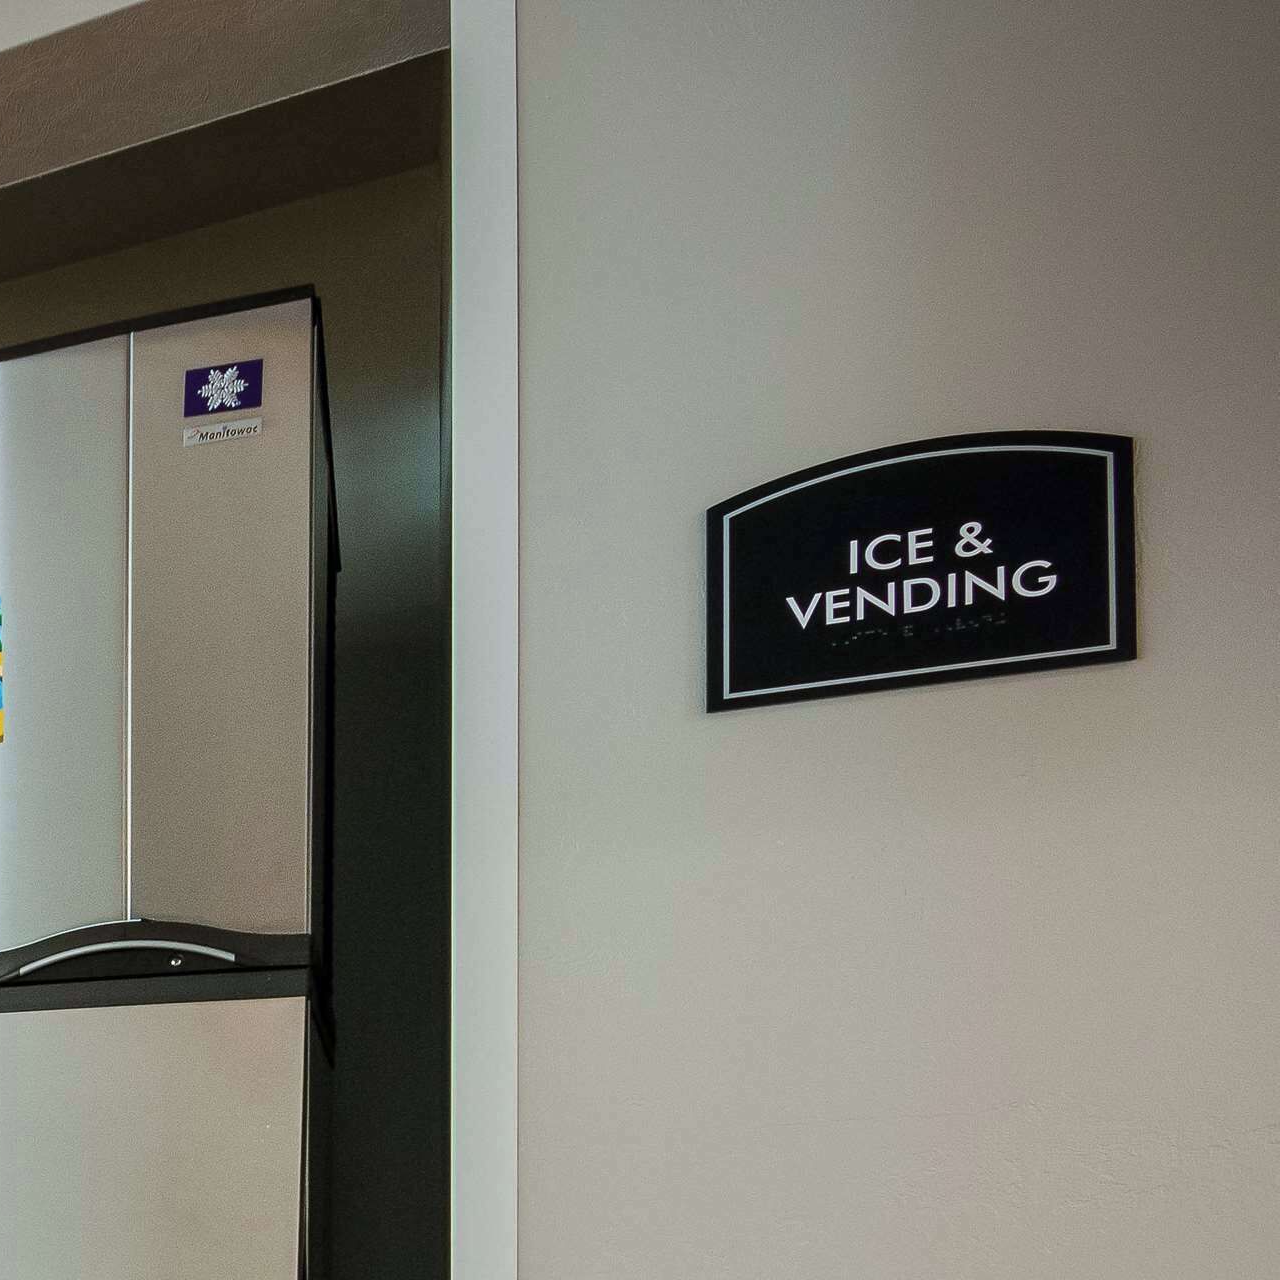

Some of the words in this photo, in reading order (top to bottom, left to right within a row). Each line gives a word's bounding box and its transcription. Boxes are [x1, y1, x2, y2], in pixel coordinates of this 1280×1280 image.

[198, 425, 258, 442] Manitowoc
[849, 527, 934, 575] ICE
[954, 521, 994, 559] &
[785, 559, 1058, 630] VENDING
